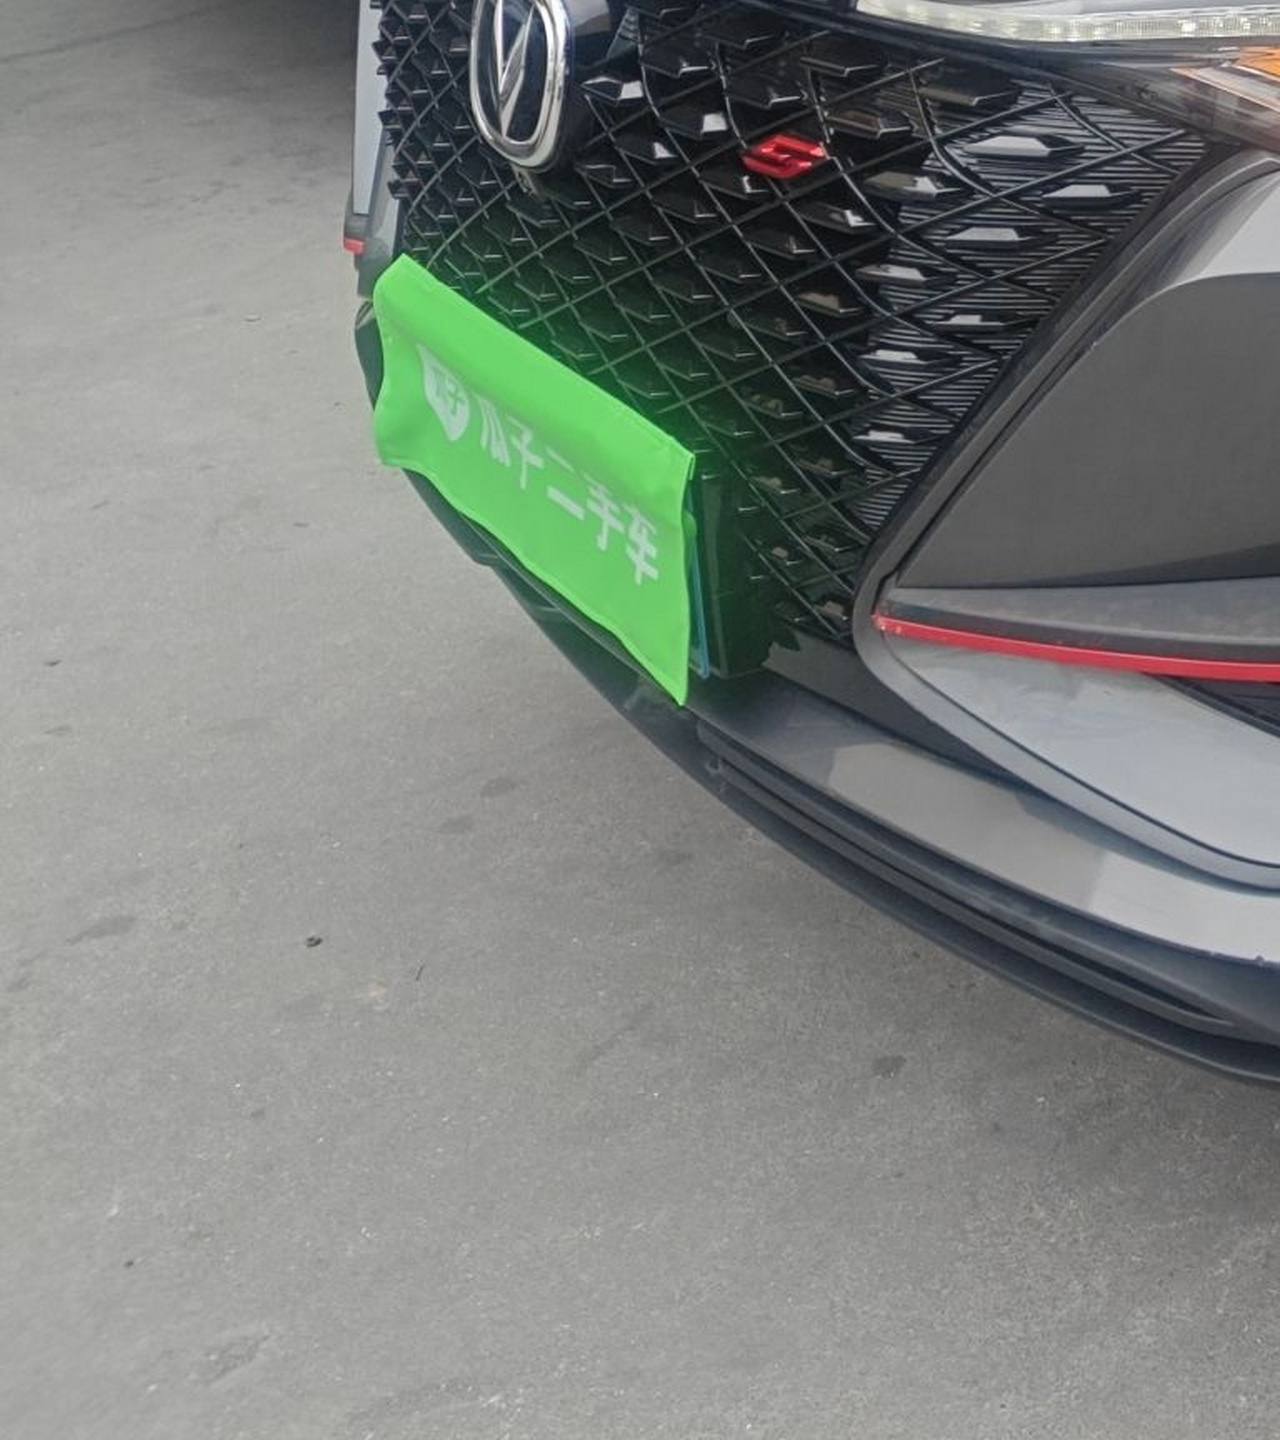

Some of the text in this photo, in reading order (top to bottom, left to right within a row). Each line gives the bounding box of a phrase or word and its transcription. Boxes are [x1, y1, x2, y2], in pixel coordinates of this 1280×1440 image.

[476, 394, 660, 586] 瓜子二手车
